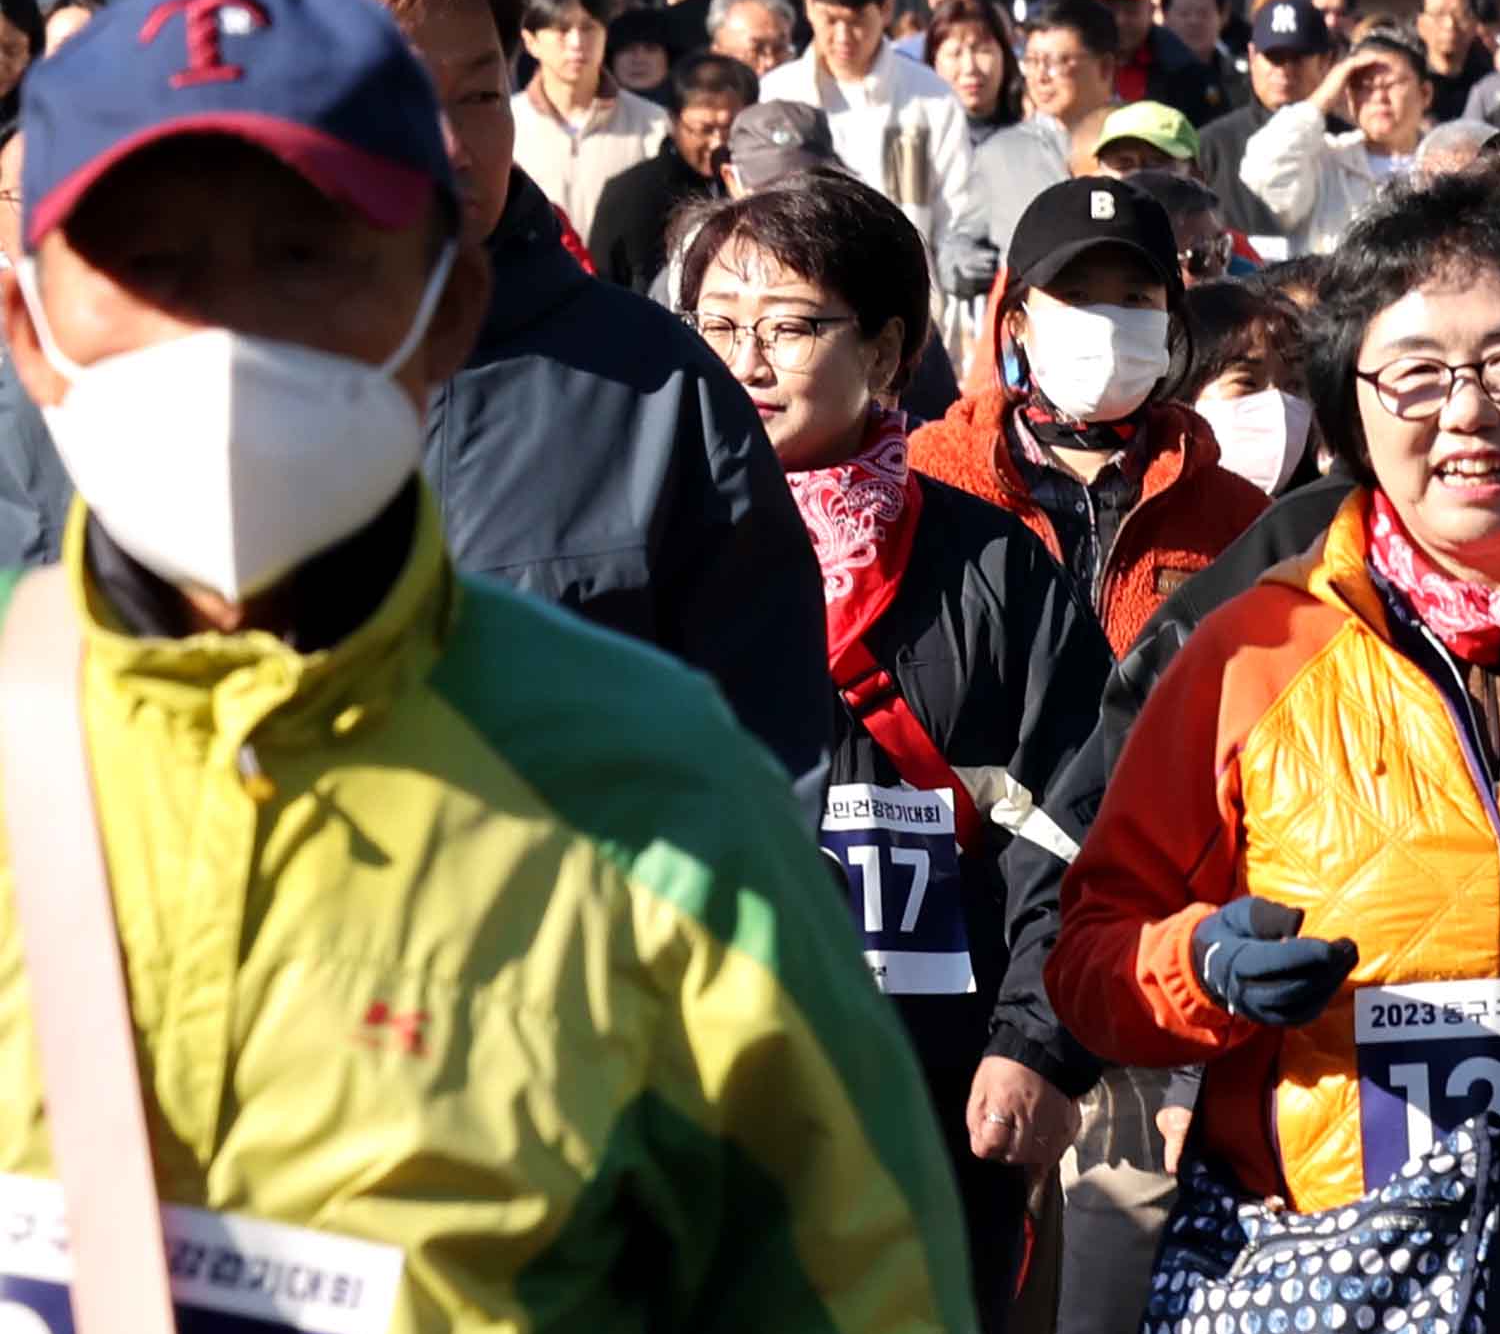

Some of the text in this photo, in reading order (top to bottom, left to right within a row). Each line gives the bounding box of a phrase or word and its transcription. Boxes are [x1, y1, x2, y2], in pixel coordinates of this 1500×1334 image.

[1090, 190, 1115, 219] B
[825, 798, 941, 825] 민건강걷기대회
[820, 845, 930, 934] 17
[1371, 1003, 1436, 1028] 2023
